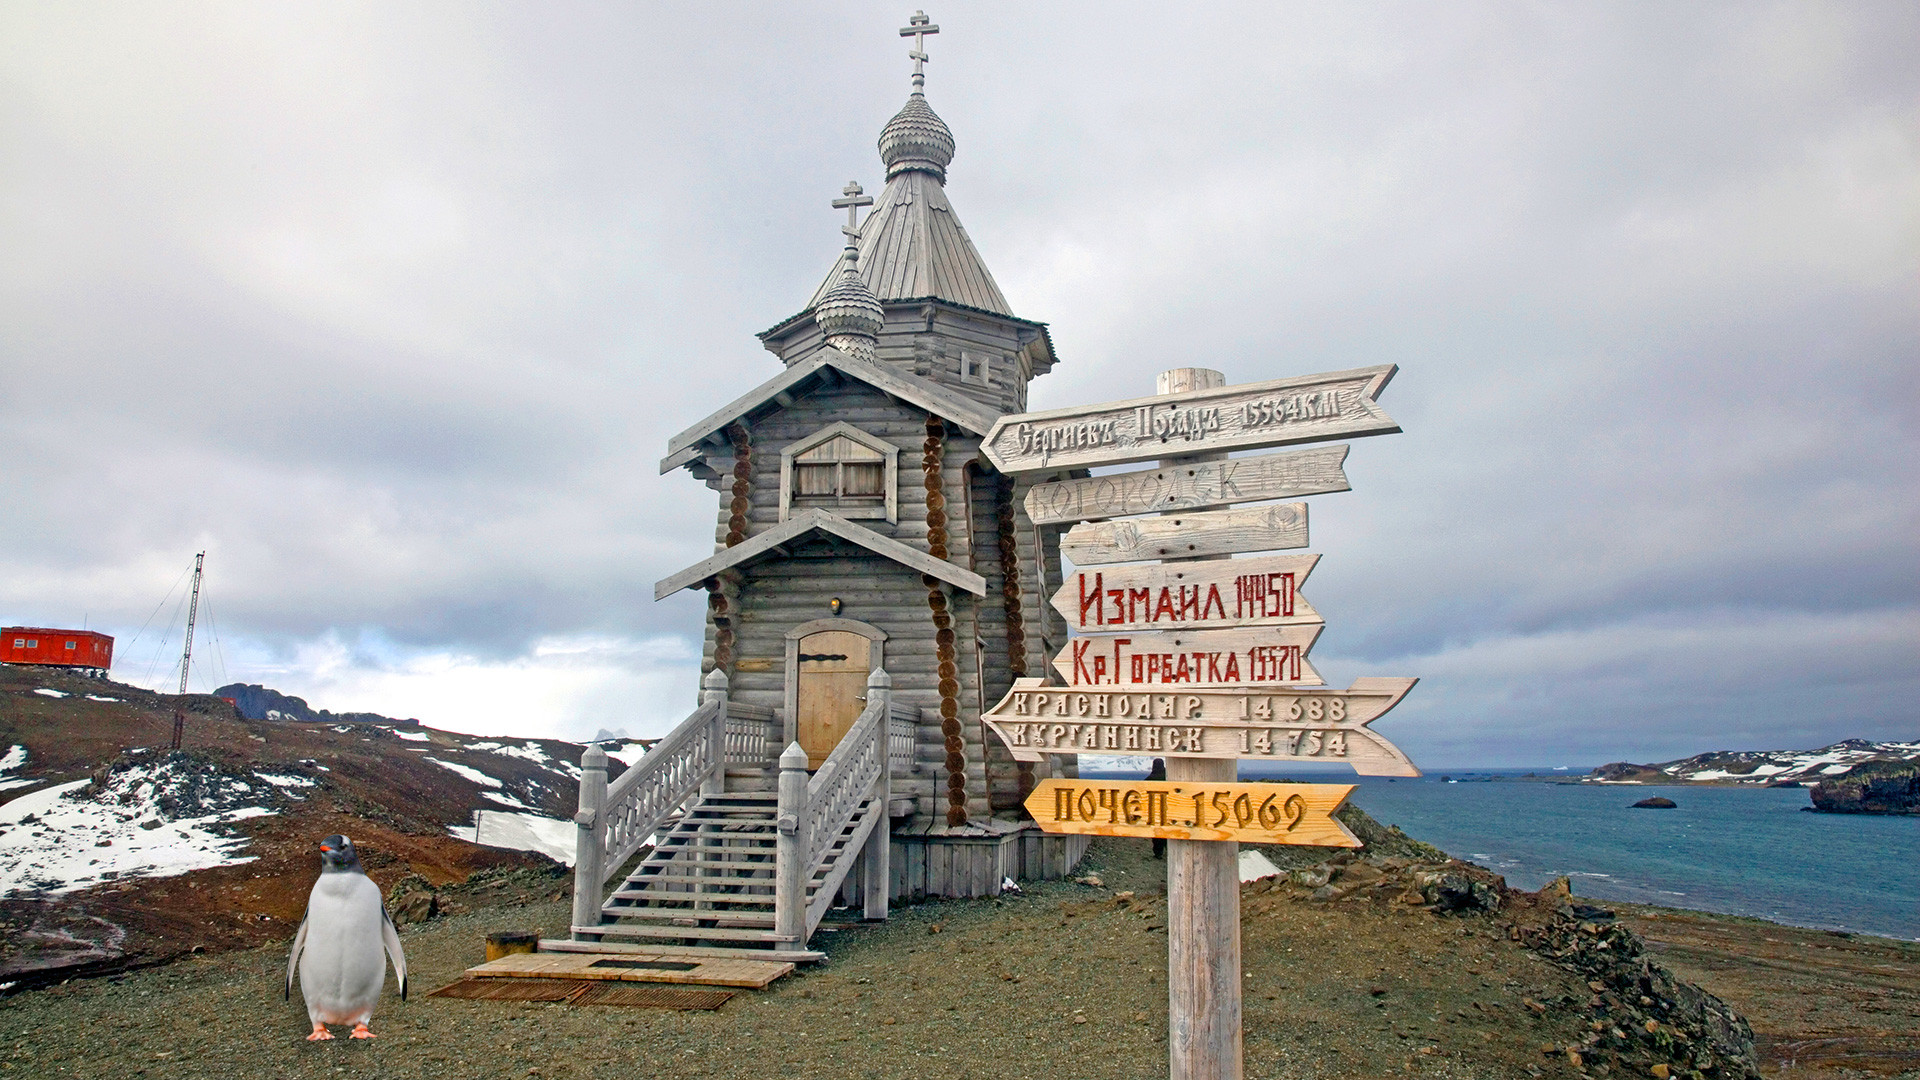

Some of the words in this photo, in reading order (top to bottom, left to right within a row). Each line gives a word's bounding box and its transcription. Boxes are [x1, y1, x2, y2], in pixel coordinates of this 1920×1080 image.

[1013, 692, 1202, 720] КРАСНОДАР
[1238, 695, 1273, 720] 14
[1288, 696, 1347, 722] 688
[1012, 723, 1204, 753] КУРГАНИНСК
[1238, 728, 1272, 754] 14
[1053, 787, 1170, 827] ПОЧЕП
[1191, 790, 1308, 833] 15069
